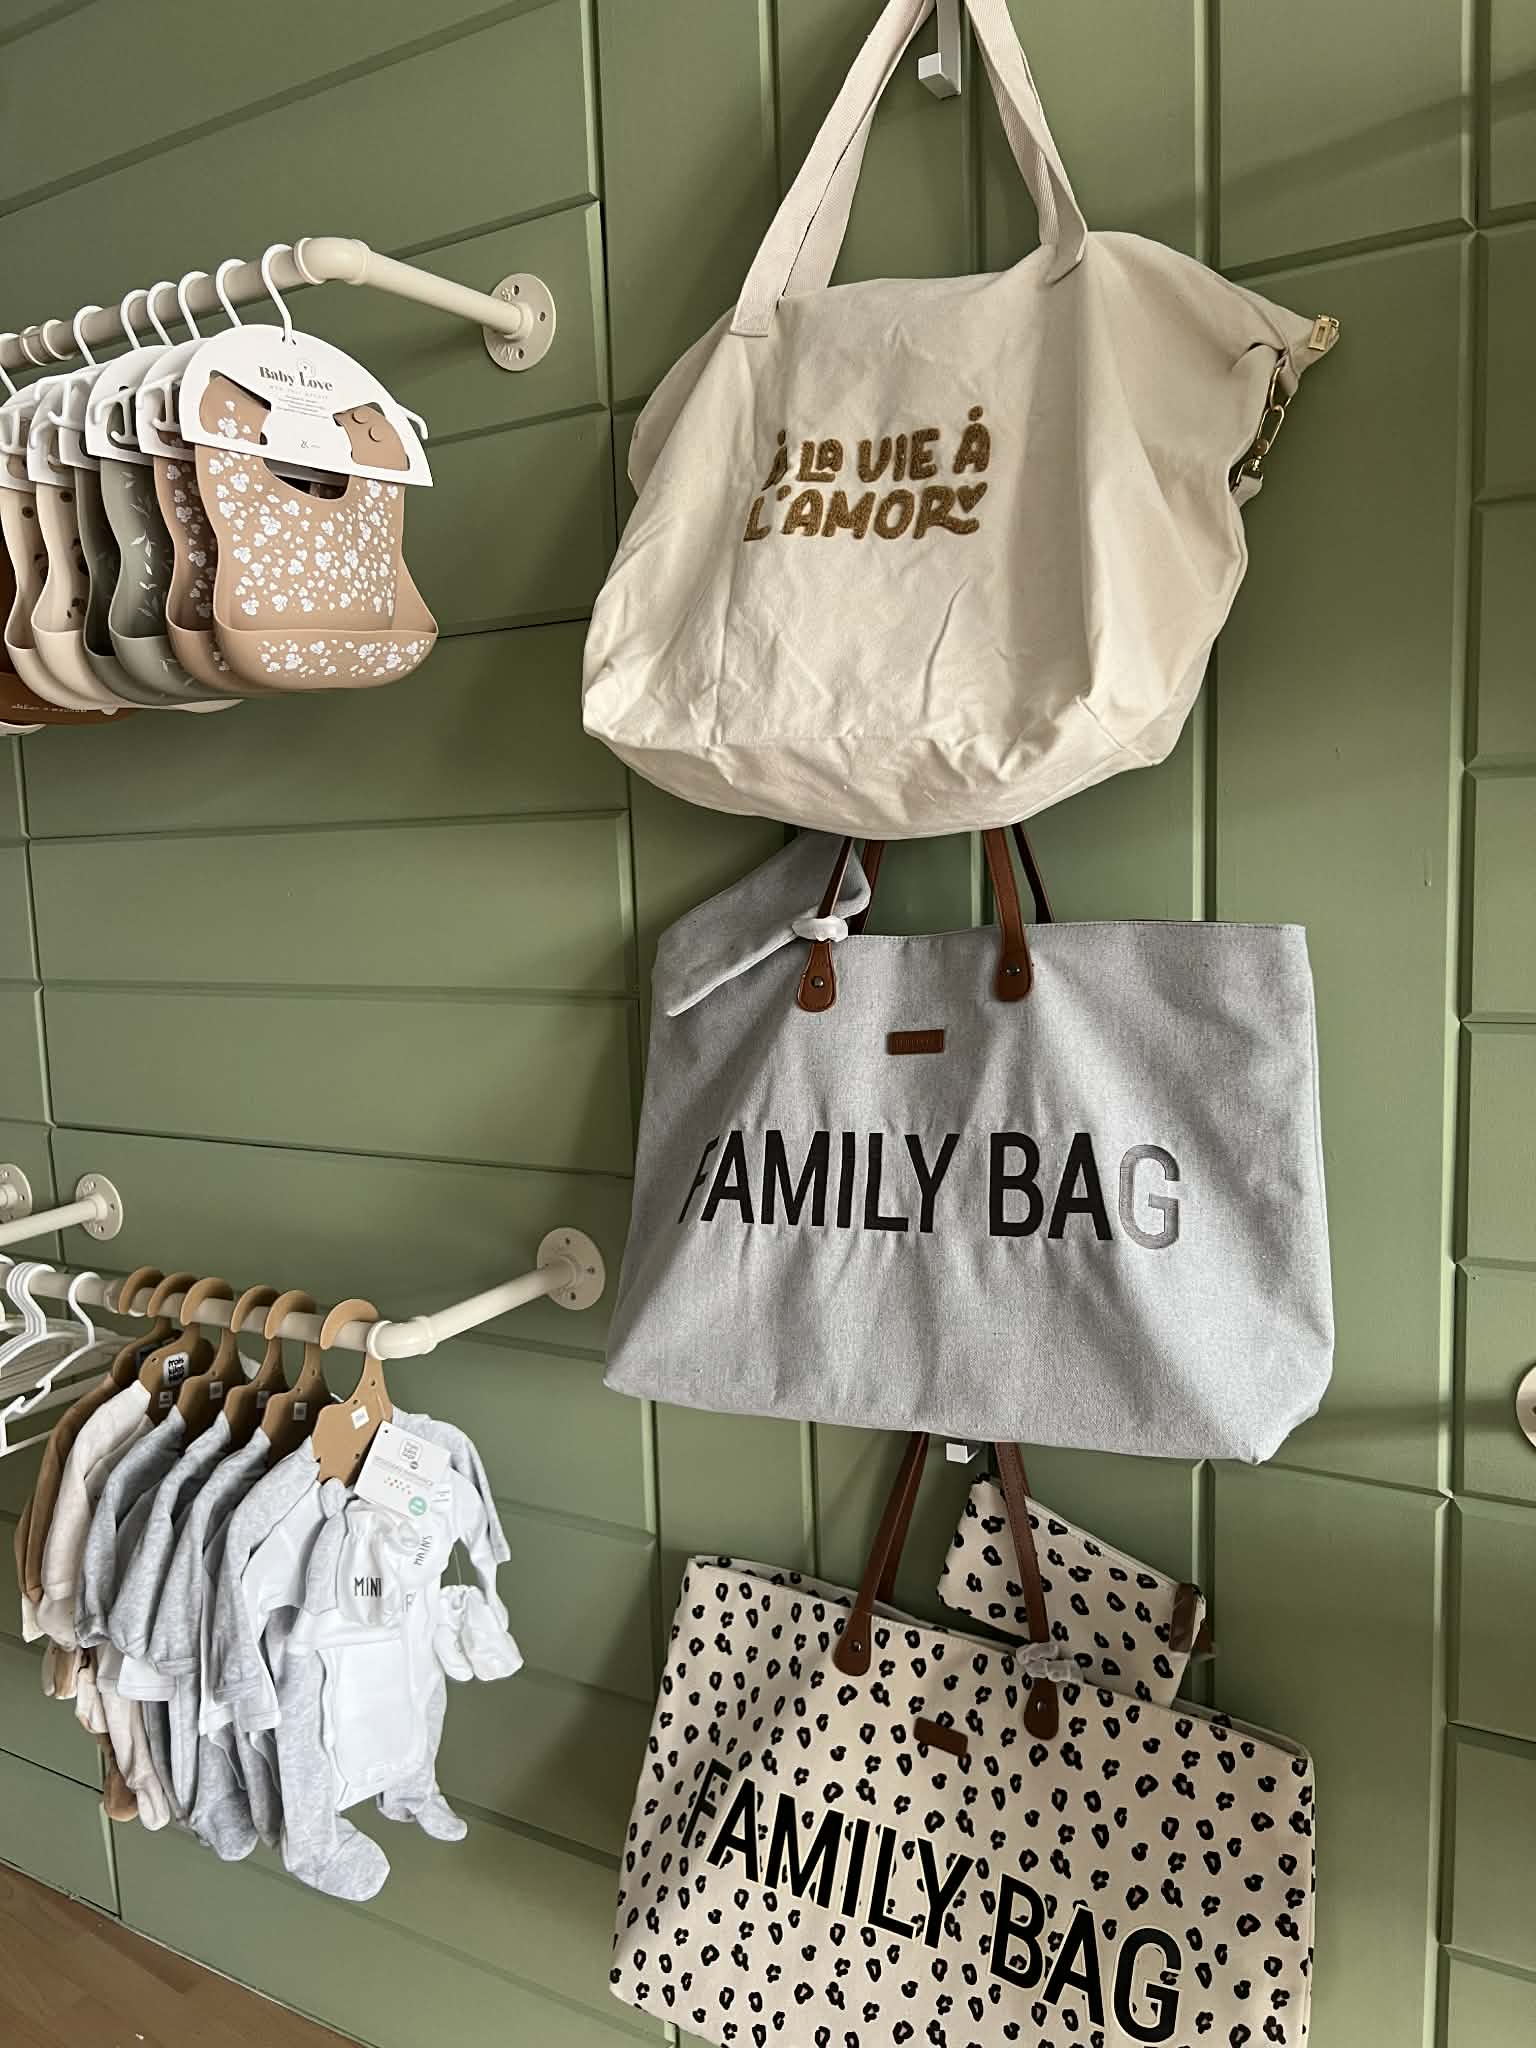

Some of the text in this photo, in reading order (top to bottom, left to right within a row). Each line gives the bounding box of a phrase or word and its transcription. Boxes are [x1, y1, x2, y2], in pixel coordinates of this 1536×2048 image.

[258, 366, 333, 391] Baby Love
[796, 438, 844, 482] LA
[857, 428, 940, 483] VIE
[677, 1129, 1181, 1250] FAMILY BAG
[413, 1536, 433, 1566] MAINS
[354, 1576, 383, 1598] MINI
[681, 1758, 1182, 2043] FAMILY BAG
